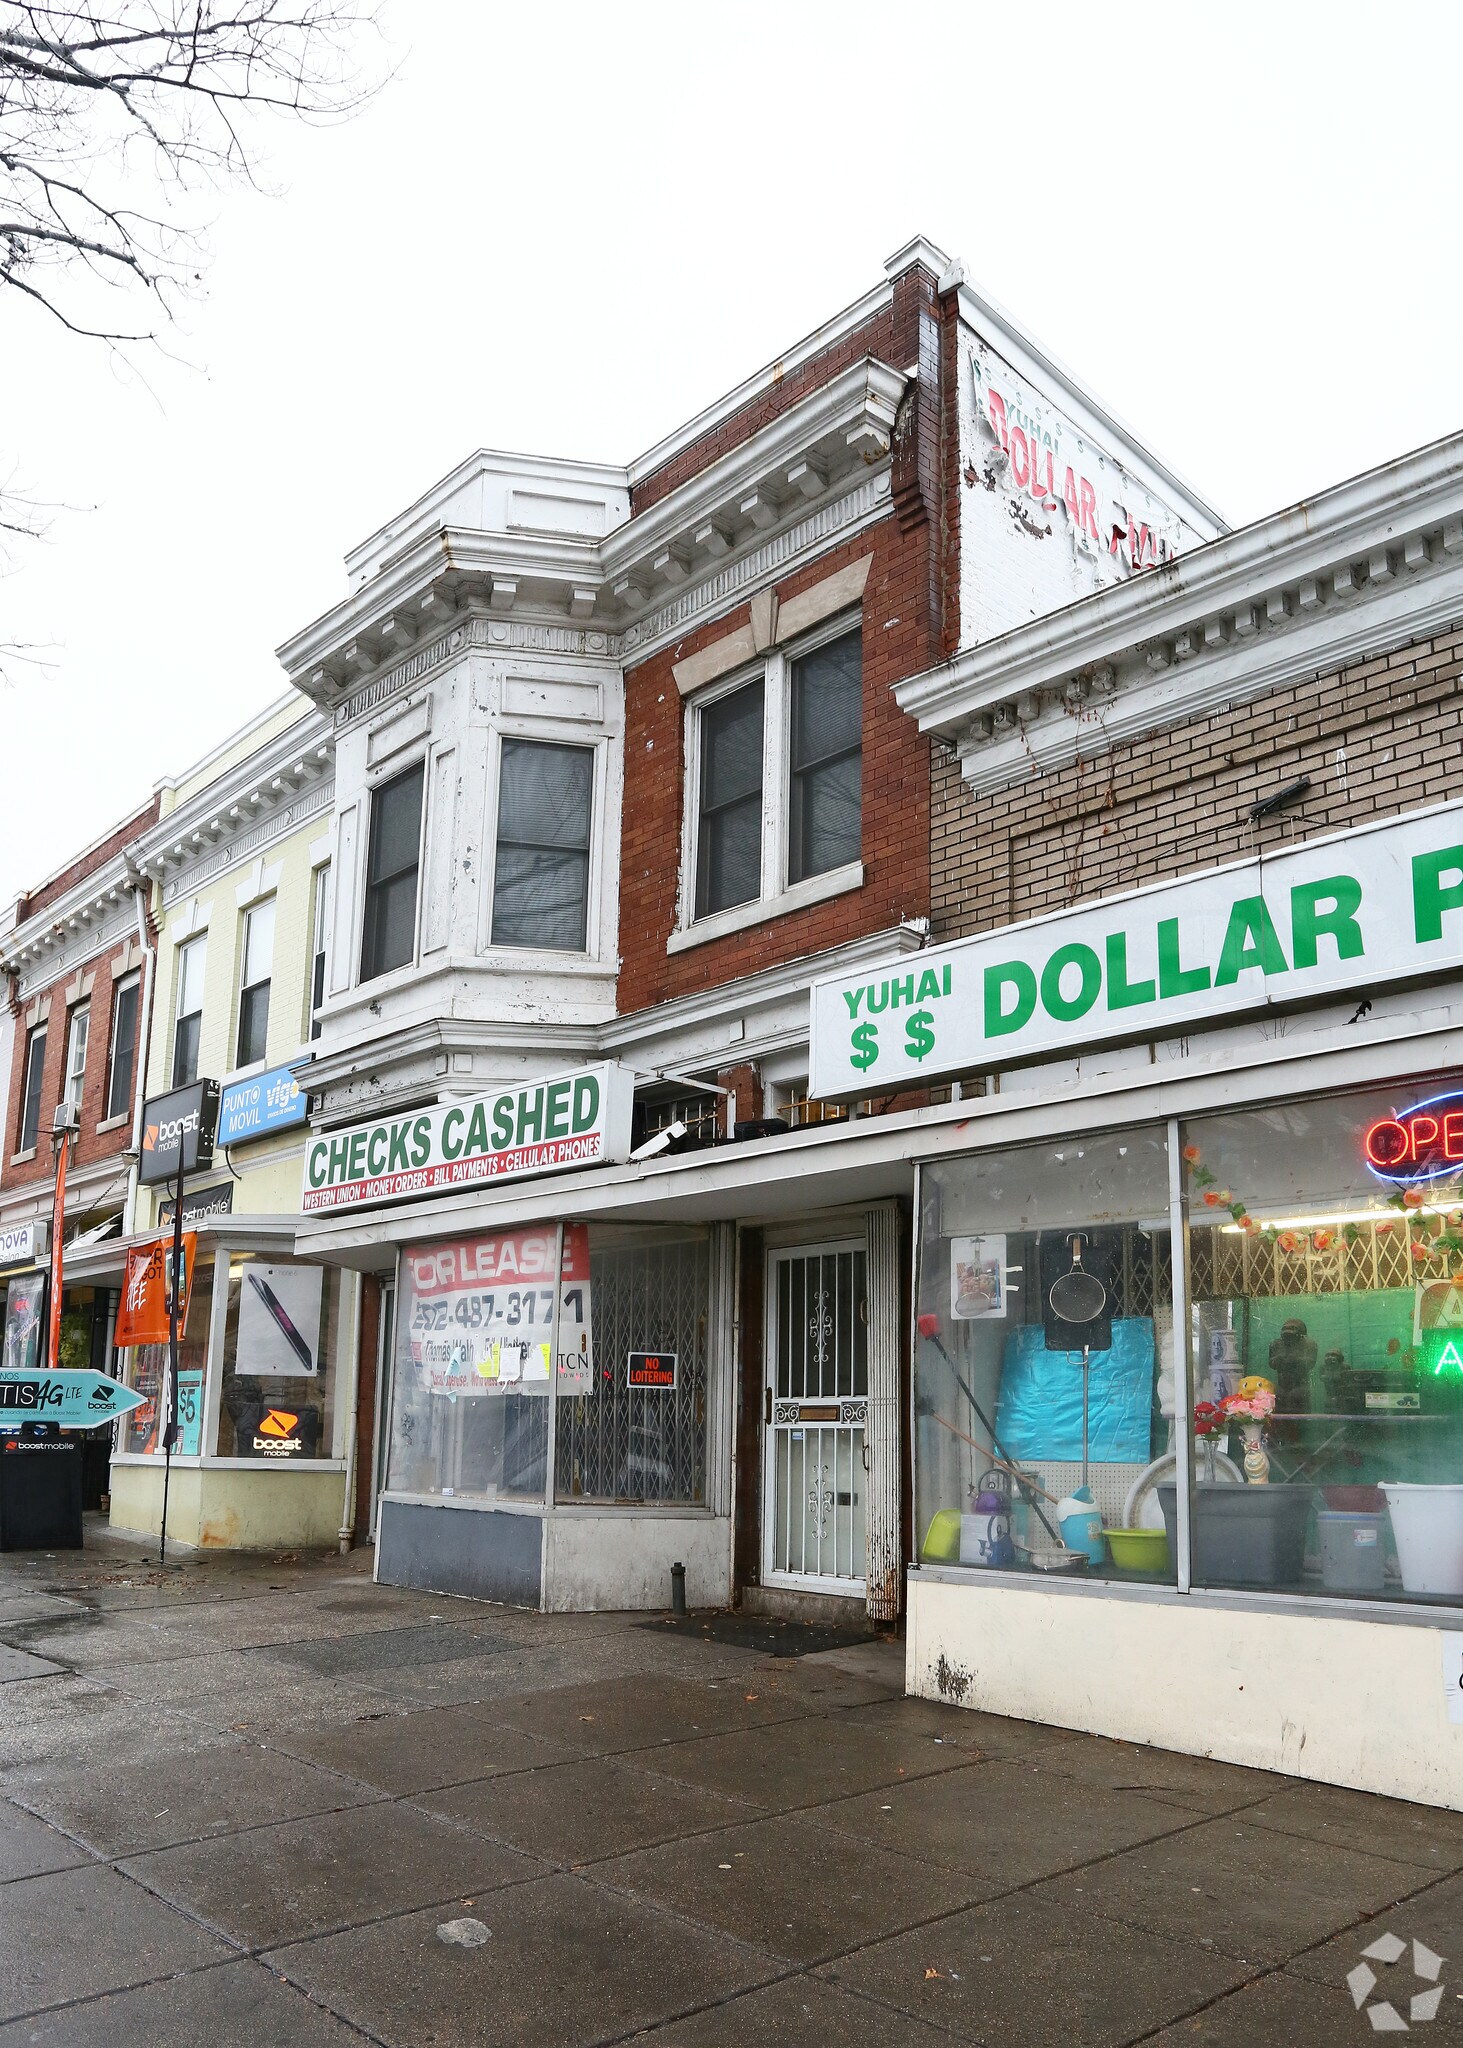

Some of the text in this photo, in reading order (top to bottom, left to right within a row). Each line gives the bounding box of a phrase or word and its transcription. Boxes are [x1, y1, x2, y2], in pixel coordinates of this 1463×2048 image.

[1004, 398, 1059, 456] YUHAI
[984, 874, 1364, 1039] DOLLAR
[842, 963, 952, 1020] YUHAI
[223, 1085, 260, 1115] PUNTO
[267, 1078, 300, 1108] vigo
[158, 1108, 199, 1141] boost
[228, 1107, 261, 1133] MOVIL
[308, 1075, 600, 1188] CHECKS CASHED
[158, 1138, 180, 1153] mobile
[304, 1135, 601, 1210] WESTERN UNION MONEY ORDERS BILL PAYMENTS CELLULAR PHONES
[460, 1236, 574, 1282] LEASE
[630, 1370, 673, 1384] LOITERING
[645, 1357, 660, 1370] NO
[66, 1386, 83, 1399] LTE
[87, 1401, 117, 1410] boost
[179, 1387, 196, 1424] $5
[253, 1436, 302, 1451] boost
